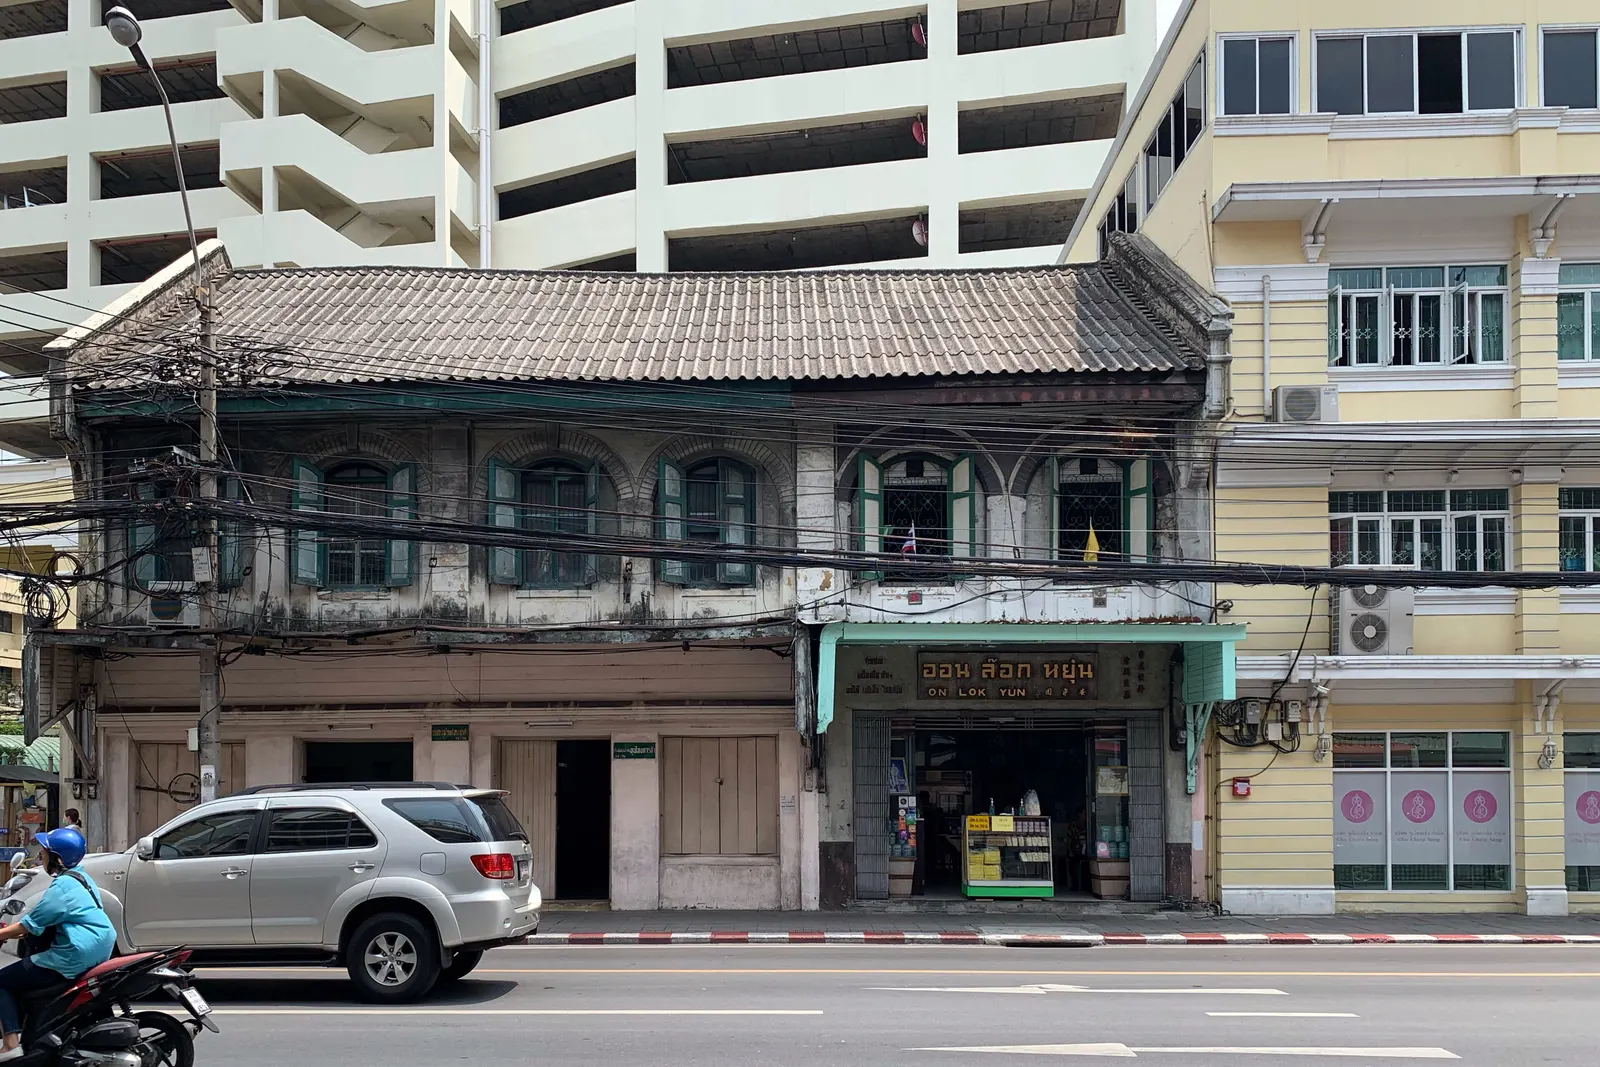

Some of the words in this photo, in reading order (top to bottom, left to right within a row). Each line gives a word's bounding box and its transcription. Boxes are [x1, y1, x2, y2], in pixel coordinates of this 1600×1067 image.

[922, 663, 970, 679] ออน
[1043, 658, 1094, 685] หยุ่น
[928, 687, 948, 697] ON
[958, 687, 987, 697] LOK
[999, 687, 1027, 697] YUN
